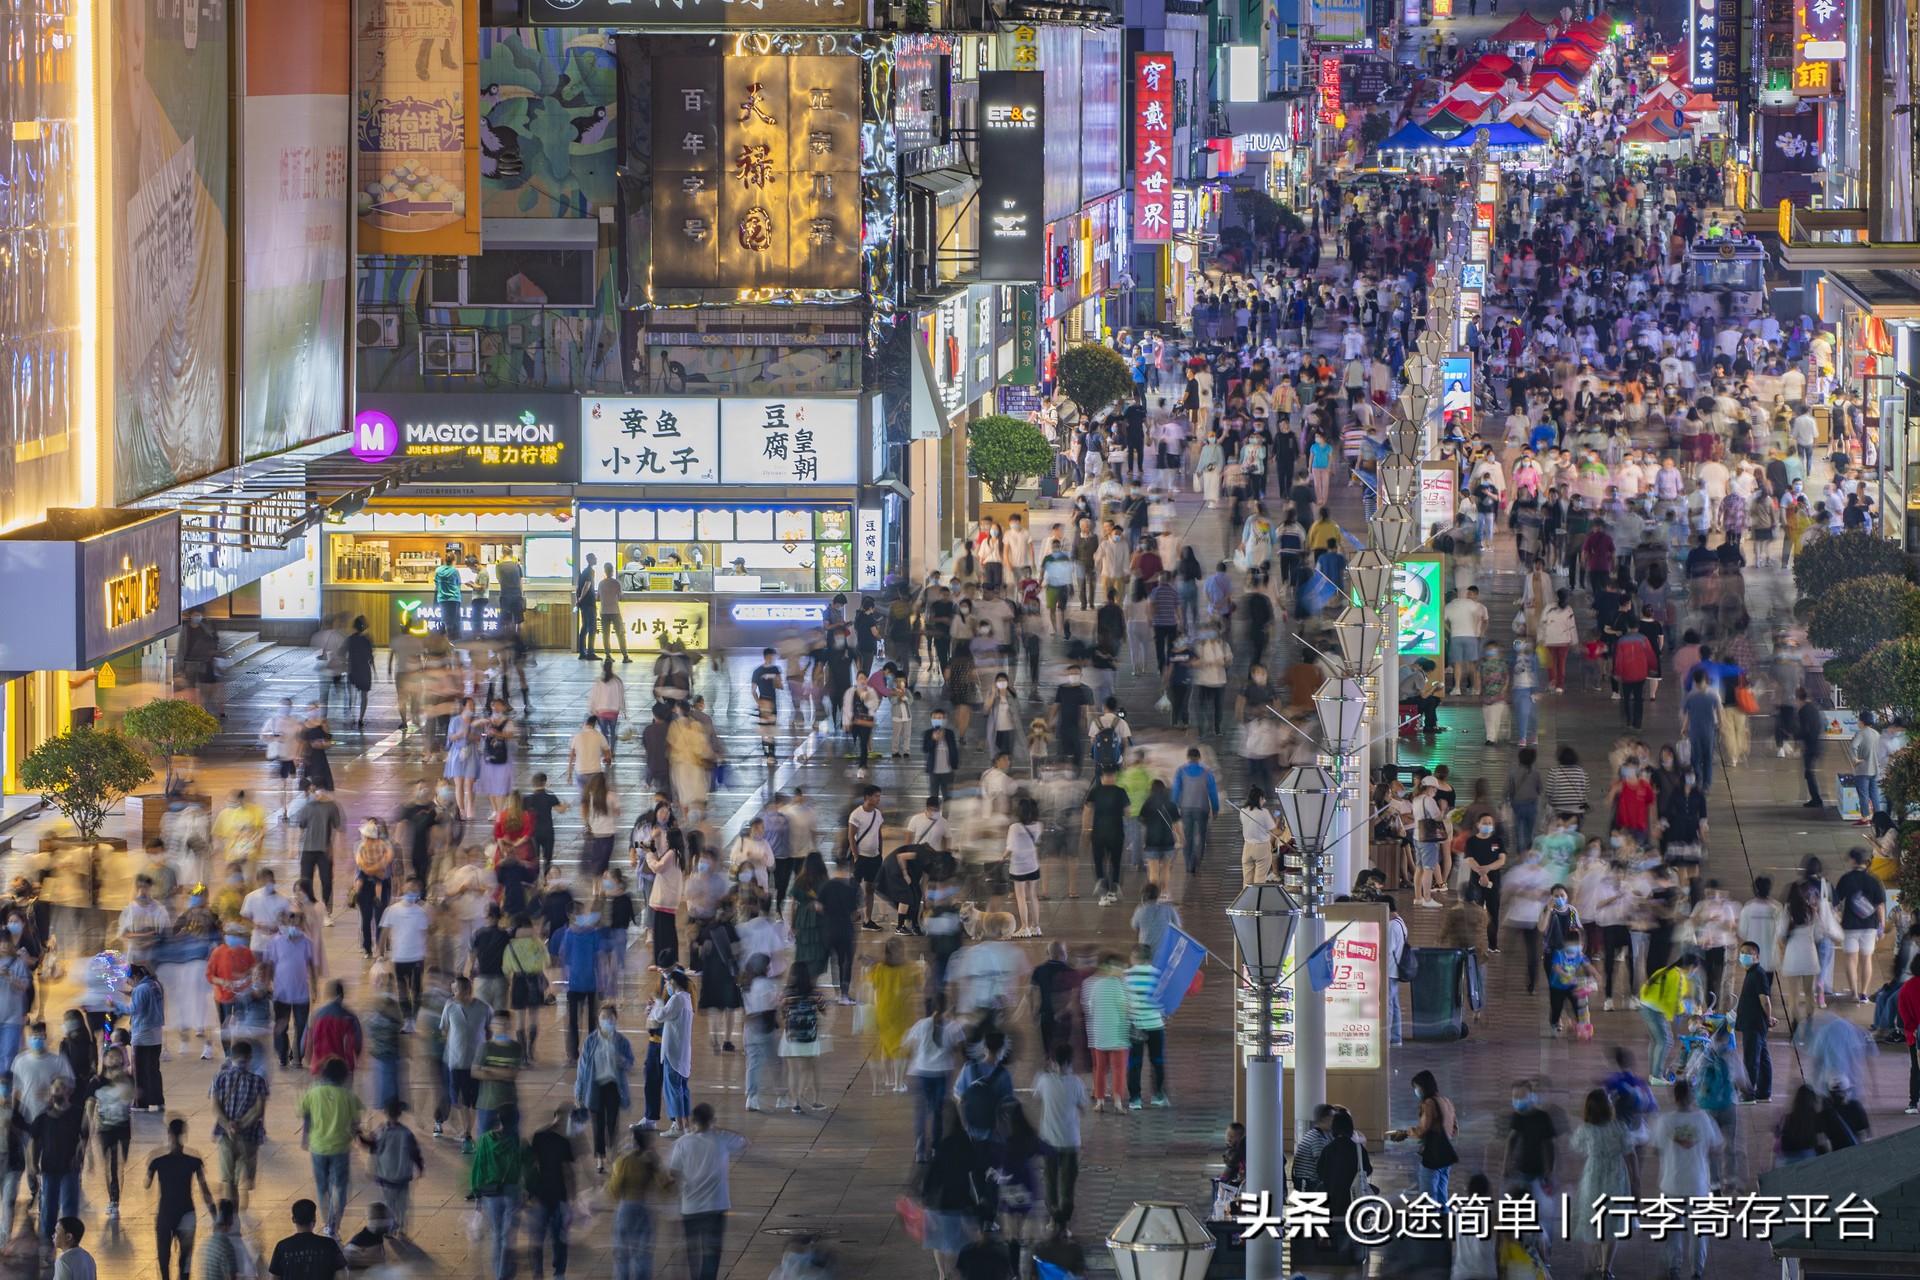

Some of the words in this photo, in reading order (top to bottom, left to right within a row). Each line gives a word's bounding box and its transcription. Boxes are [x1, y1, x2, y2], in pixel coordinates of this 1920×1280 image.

[1013, 25, 1036, 71] 台东
[1718, 1, 1737, 77] 国际美肤
[1715, 87, 1738, 96] 上平台
[988, 106, 1036, 121] EF&C
[379, 132, 441, 150] 进行到底
[1142, 61, 1168, 234] 穿戴大世界
[1246, 133, 1287, 150] HUA
[681, 88, 706, 243] 百年字号
[809, 88, 834, 246] 正宗川菜
[1003, 200, 1015, 208] BY
[361, 423, 384, 450] M
[407, 424, 479, 442] MAGIC
[483, 424, 554, 442] LEMON
[620, 408, 681, 439] 章鱼
[762, 404, 789, 460] 豆腐
[407, 446, 431, 455] JUICE
[482, 446, 558, 463] 魔力柠檬
[602, 446, 699, 475] 小丸子
[792, 428, 817, 481] 皇朝
[864, 520, 876, 577] 豆腐皇朝
[1342, 1024, 1370, 1032] 2020
